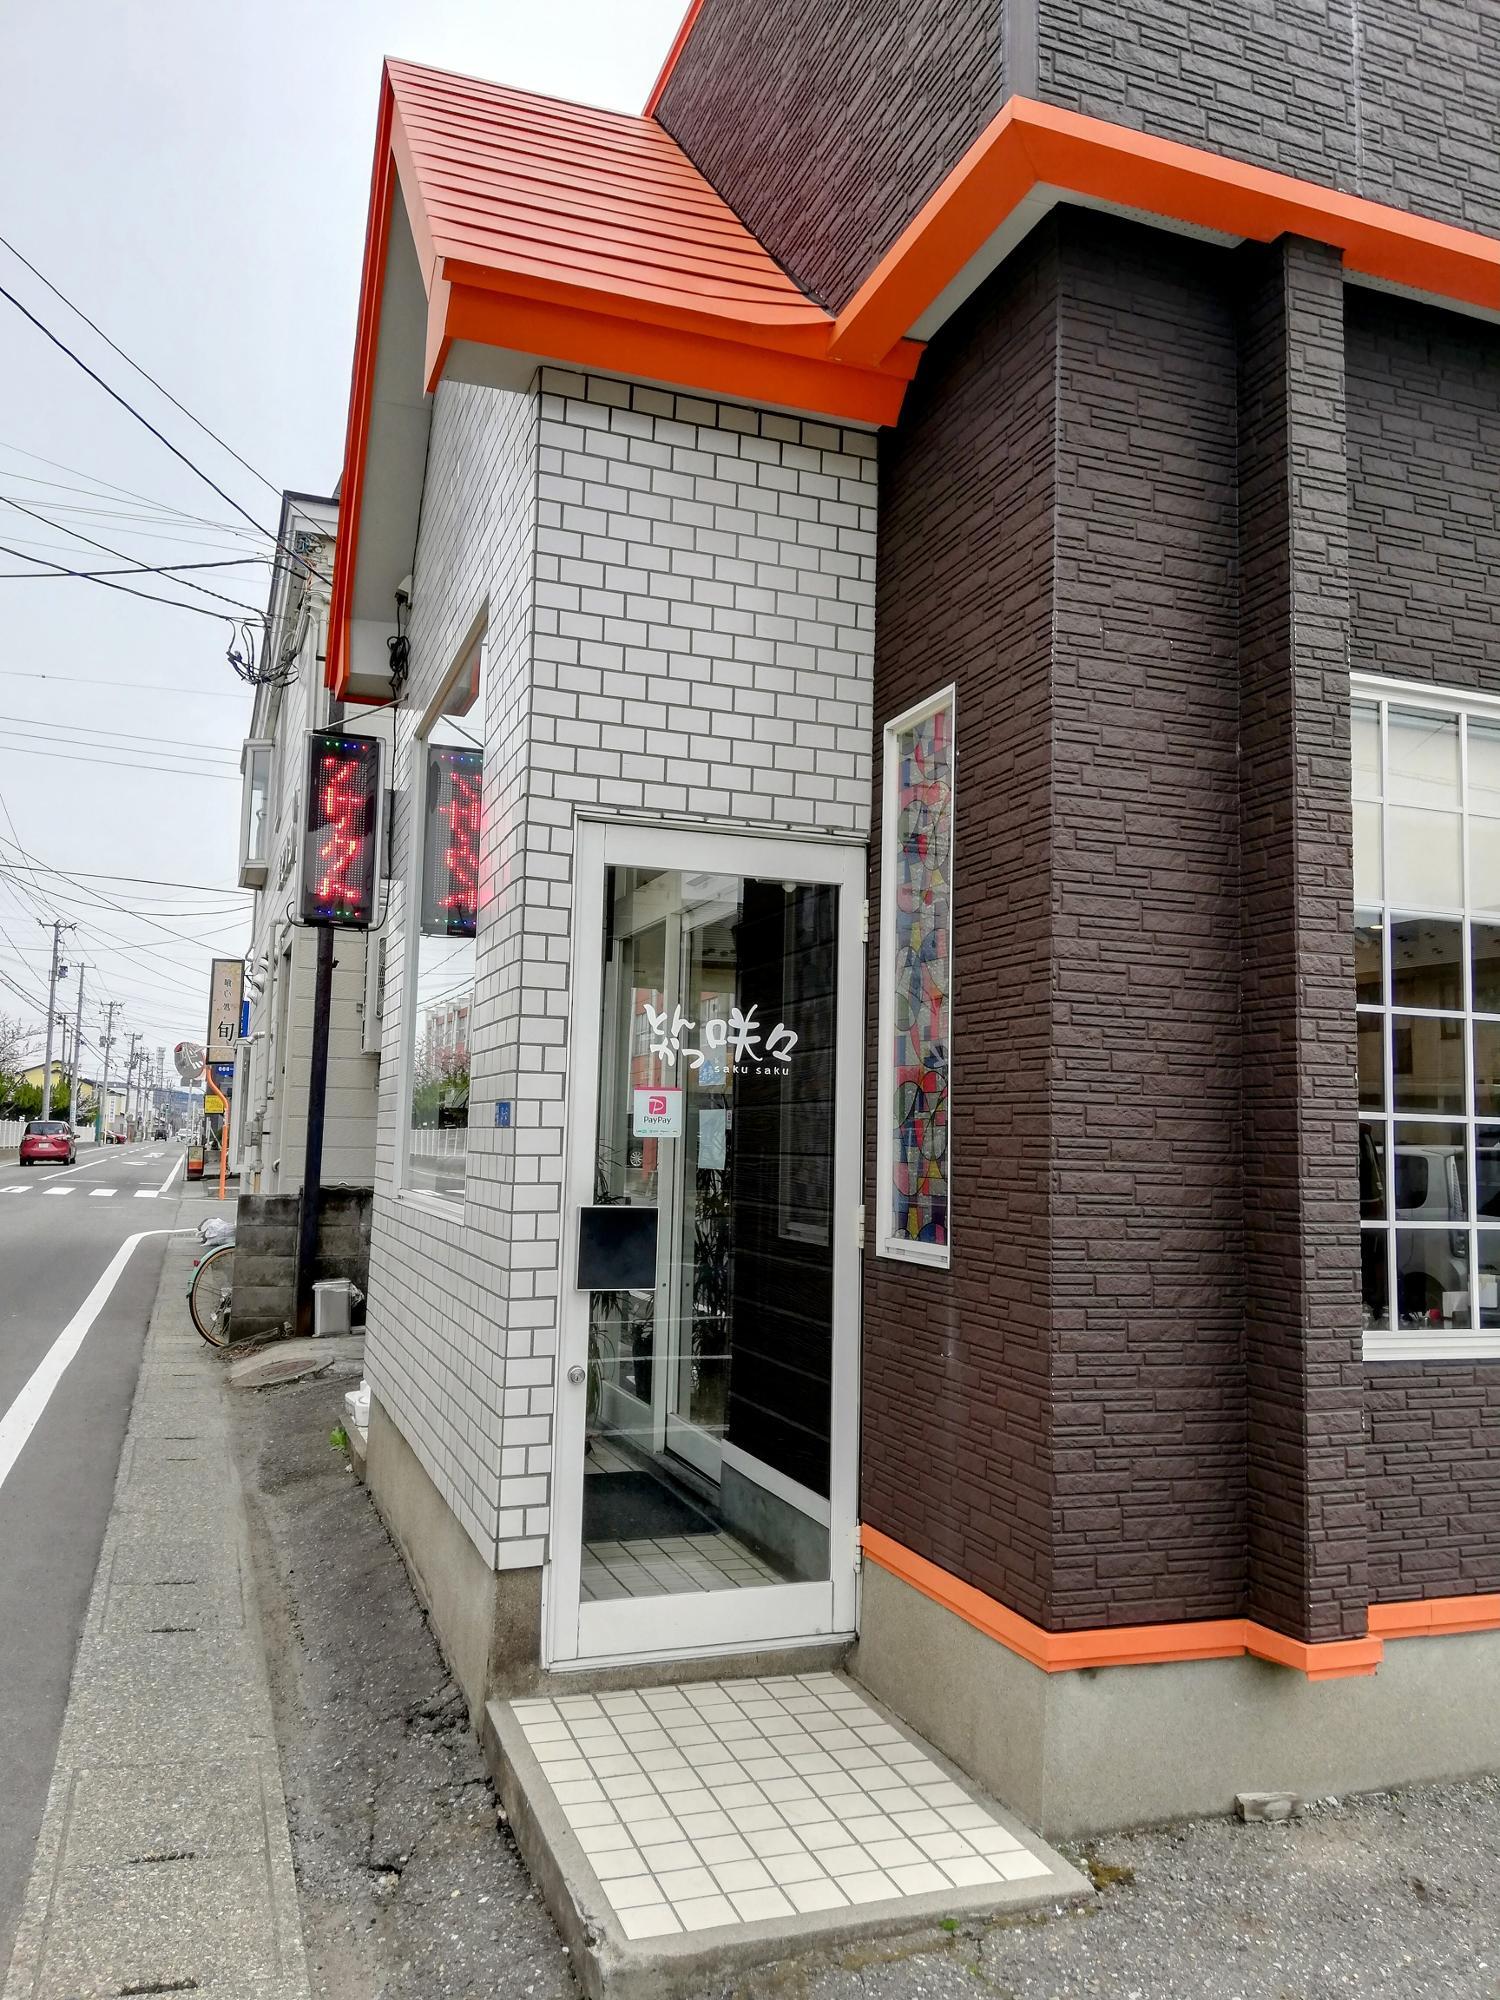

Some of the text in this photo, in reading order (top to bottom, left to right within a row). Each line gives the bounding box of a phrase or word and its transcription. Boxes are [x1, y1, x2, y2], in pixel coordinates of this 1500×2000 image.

[217, 1020, 235, 1042] 旬
[714, 1065, 789, 1076] saku saku
[643, 1116, 672, 1125] PayPay
